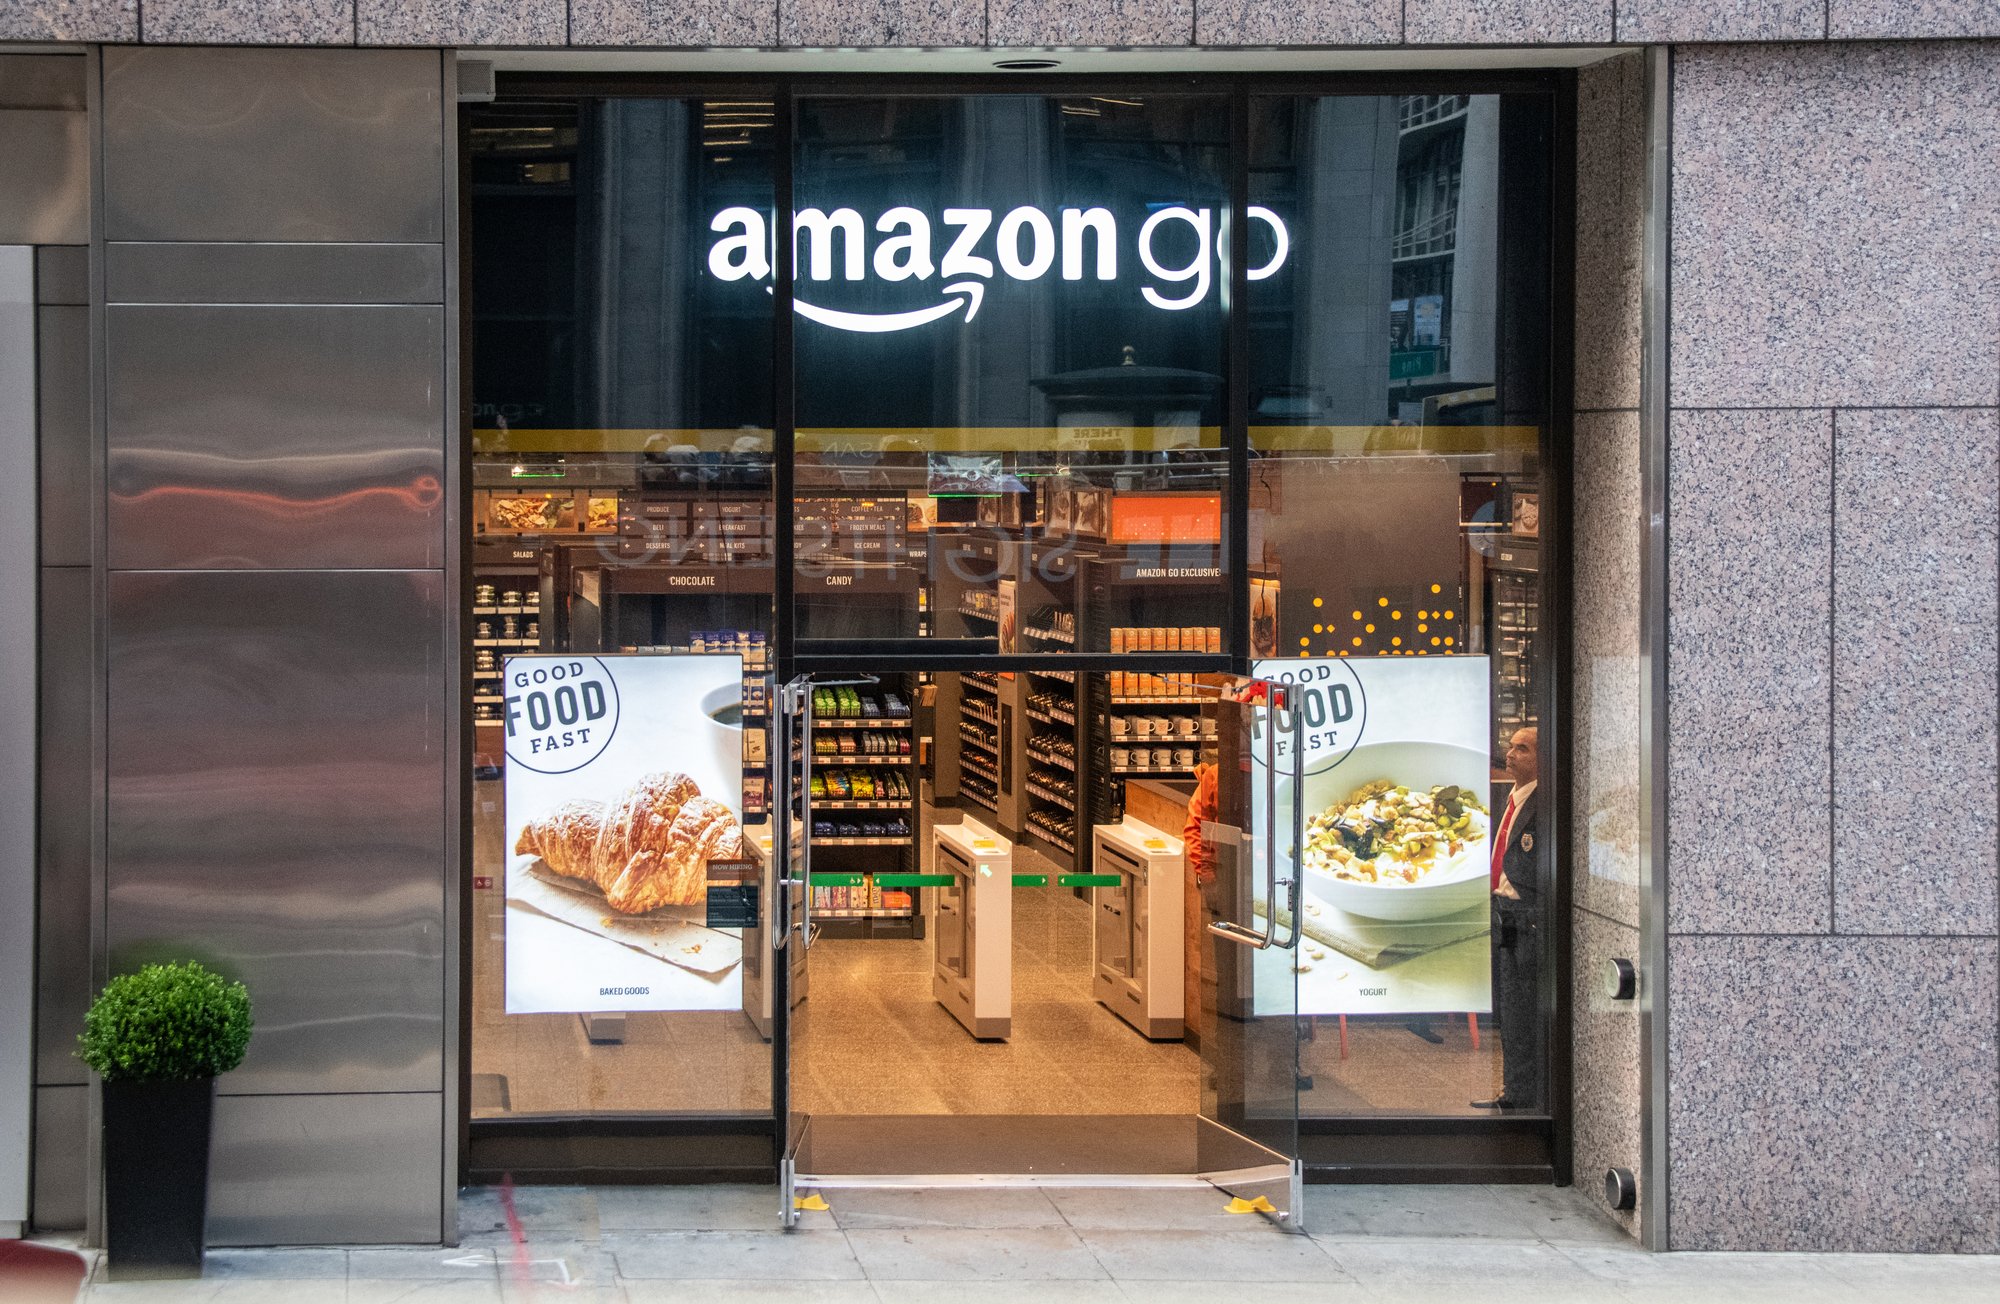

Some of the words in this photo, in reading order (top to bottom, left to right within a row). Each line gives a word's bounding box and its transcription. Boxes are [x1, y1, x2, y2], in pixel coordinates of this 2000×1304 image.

[708, 206, 1117, 281] amazon
[1138, 206, 1289, 311] go
[512, 551, 534, 559] SALADS
[1136, 568, 1166, 577] AMAZON
[1168, 568, 1178, 577] GO
[669, 576, 715, 587] CHOCOLATE
[825, 576, 852, 586] CANDY
[514, 661, 584, 688] GOOD
[1262, 665, 1332, 686] OOD
[505, 680, 607, 738] FOOD
[530, 728, 592, 754] FAST
[1276, 730, 1338, 757] FST
[599, 987, 623, 996] BAKED
[624, 986, 650, 995] GOODS
[1358, 988, 1388, 996] YOGURT
